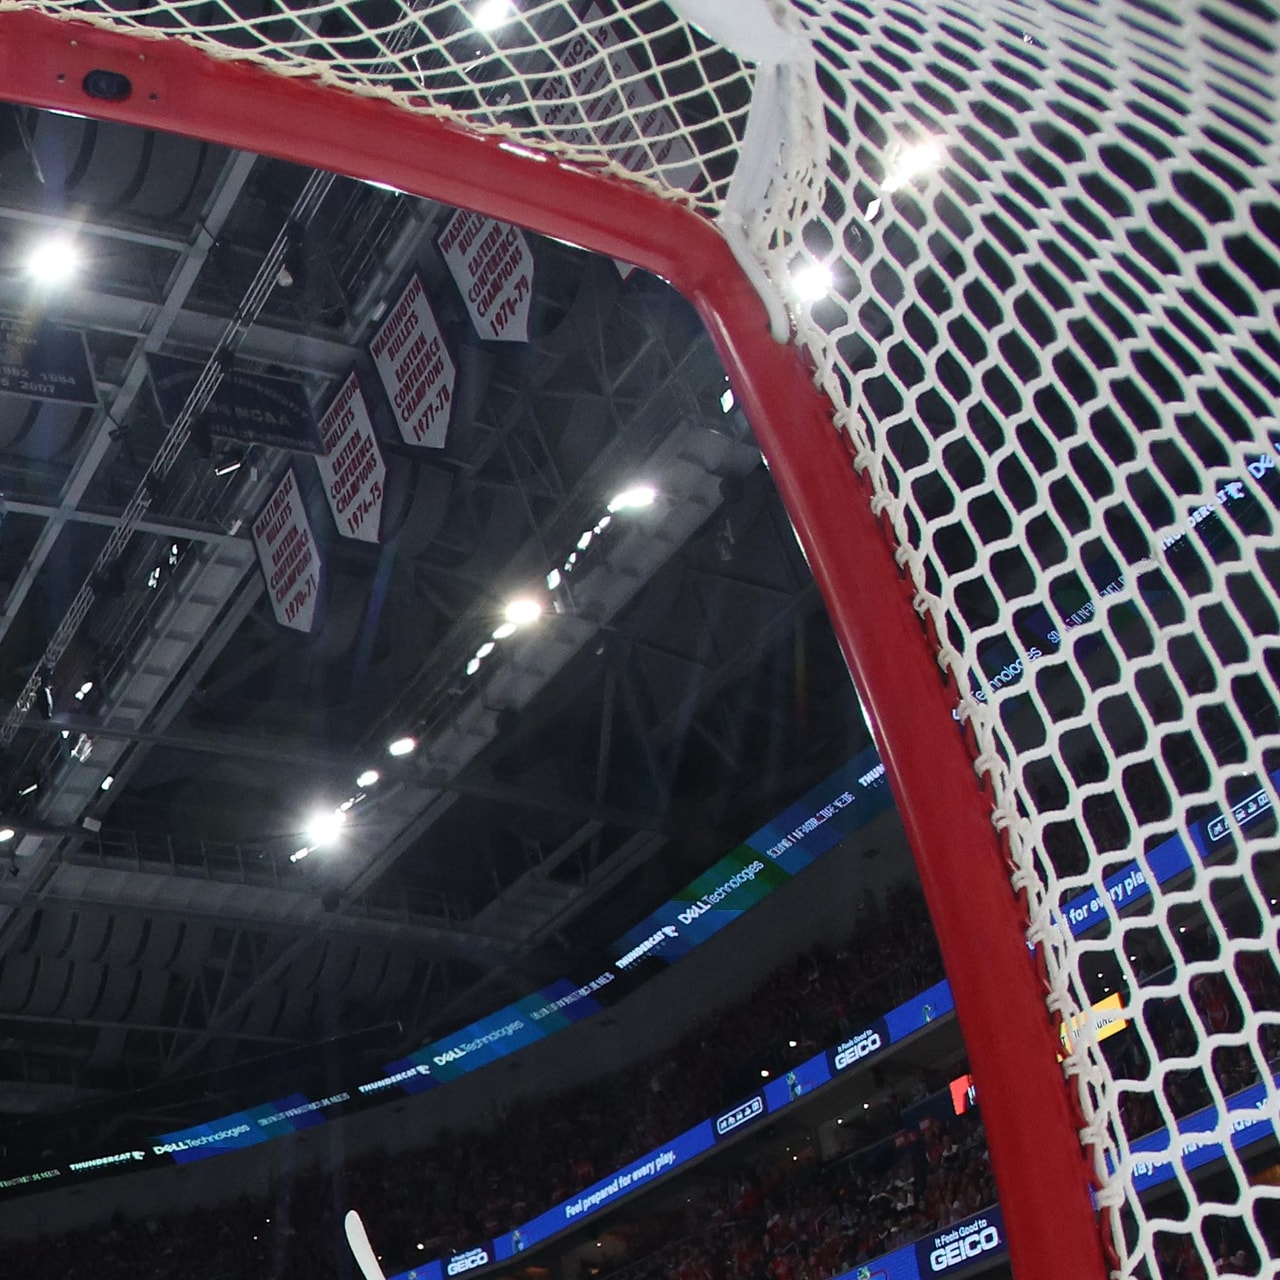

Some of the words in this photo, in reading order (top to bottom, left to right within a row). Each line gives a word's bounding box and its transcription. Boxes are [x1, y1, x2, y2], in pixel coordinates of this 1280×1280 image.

[468, 221, 504, 278] EASTERN
[468, 226, 518, 304] CONFERENCE
[476, 246, 523, 318] CHAMPIONS
[372, 278, 422, 359] WASHINGTON
[387, 310, 419, 362] BULLETS
[394, 332, 428, 384] EASTERN
[394, 336, 441, 409] CONFERENCE
[401, 356, 444, 423] CHAMPIONS
[615, 929, 665, 969] THUNDERCAT
[677, 900, 712, 925] DELL
[704, 859, 764, 908] Technologies
[835, 1033, 882, 1070] GEICO
[153, 1139, 188, 1155] DELL
[187, 1123, 250, 1149] Technologies
[930, 1225, 999, 1272] GEICO
[959, 1220, 979, 1237] Good
[978, 1219, 988, 1229] to
